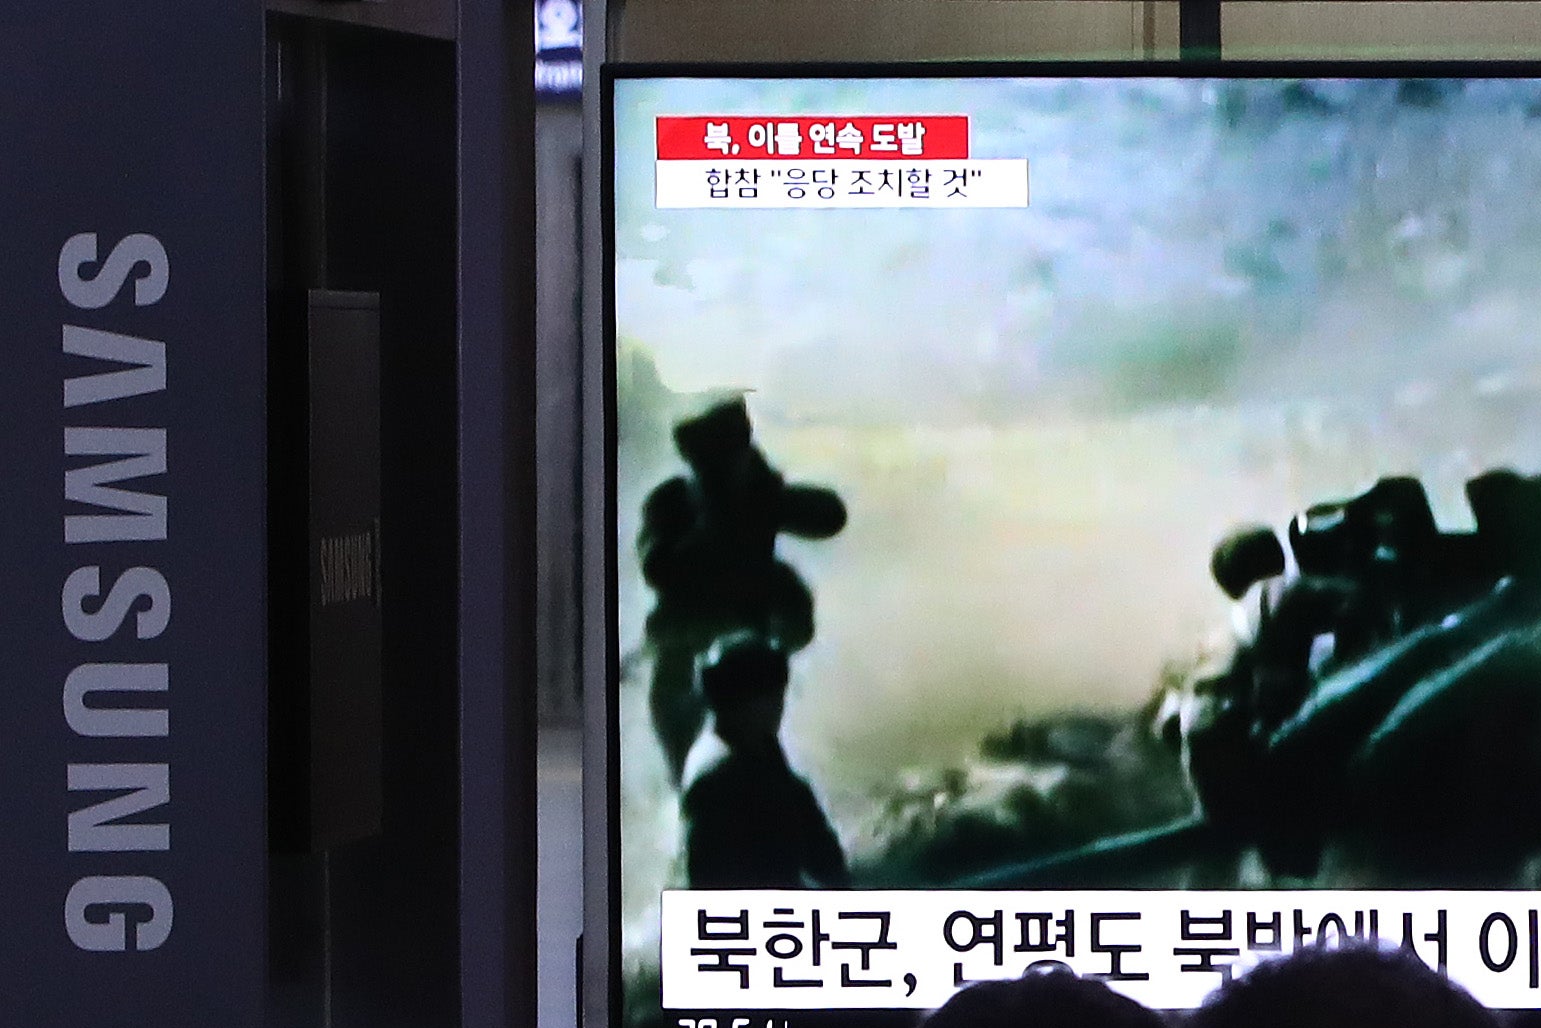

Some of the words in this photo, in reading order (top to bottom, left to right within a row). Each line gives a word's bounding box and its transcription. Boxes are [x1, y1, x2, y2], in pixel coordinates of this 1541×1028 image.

[704, 121, 740, 155] 북,
[748, 121, 803, 155] 이틀
[808, 121, 863, 155] 연속
[870, 121, 925, 155] 도발
[705, 168, 762, 198] 합참
[770, 168, 838, 199] "응당
[848, 168, 933, 199] 조치할
[943, 169, 982, 198] 것"
[57, 231, 174, 952] SAMSUNG
[690, 908, 918, 998] 북한군,
[942, 908, 1150, 986] 연평도
